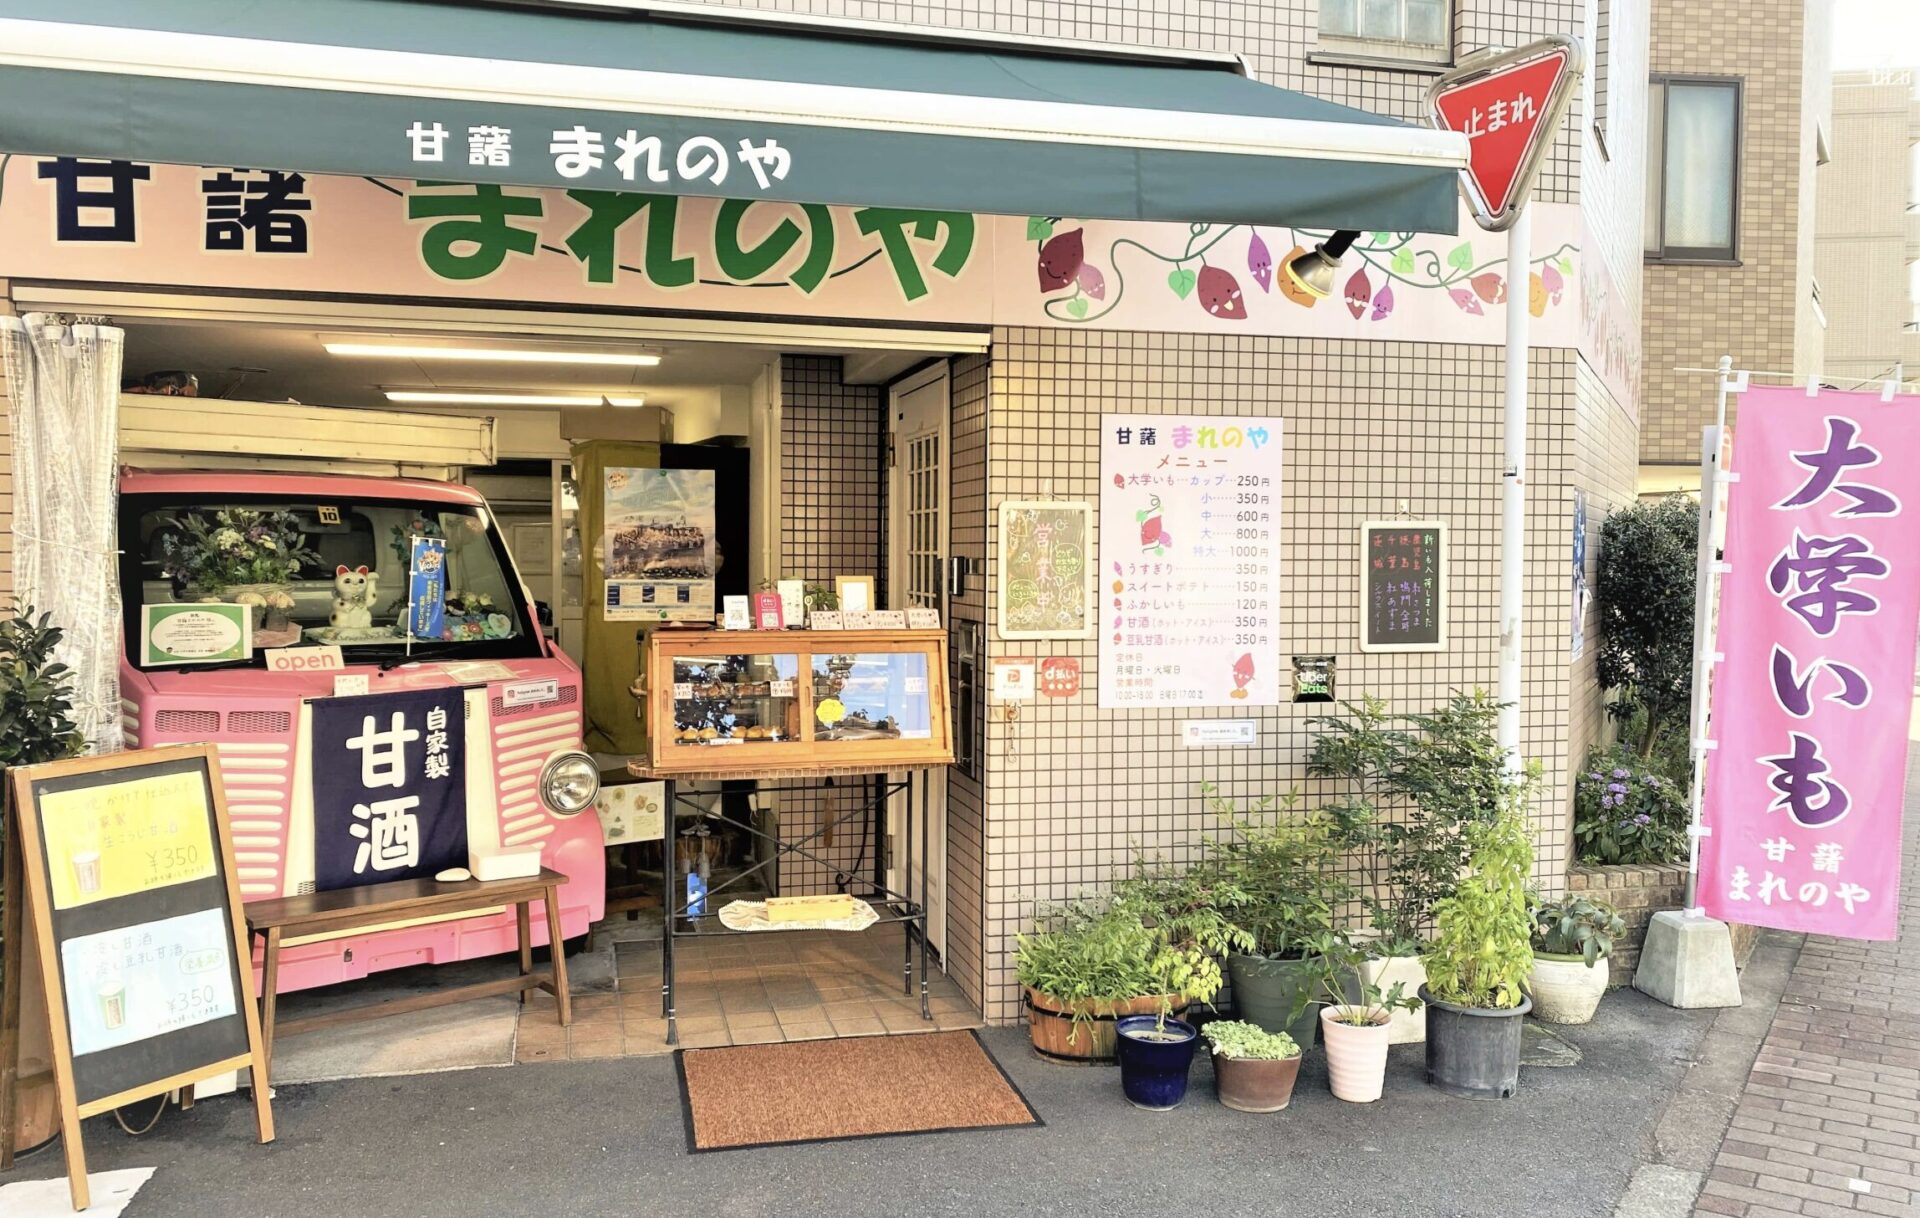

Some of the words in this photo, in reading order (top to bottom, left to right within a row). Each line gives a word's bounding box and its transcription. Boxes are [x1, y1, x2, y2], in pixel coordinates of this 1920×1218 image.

[1464, 91, 1537, 139] 止まれ
[549, 125, 792, 190] まれのや
[408, 180, 976, 302] まれのや
[1171, 425, 1269, 449] まれのや
[1157, 454, 1227, 469] メニュー
[1128, 474, 1175, 486] 大学いも
[1201, 493, 1212, 504] 小
[1201, 511, 1212, 520] 中
[1201, 528, 1212, 538] 大
[1033, 522, 1055, 614] 営業中
[1129, 563, 1173, 575] うすぎり
[1127, 581, 1209, 592] スイートポテト
[1127, 599, 1185, 610] ふかしいも
[1762, 418, 1898, 826] 大学いも
[275, 652, 336, 673] open
[1300, 671, 1328, 682] Uber
[1301, 683, 1328, 694] Eats
[424, 706, 450, 779] 自家製
[346, 711, 420, 874] 甘酒
[1727, 866, 1870, 915] まれのや
